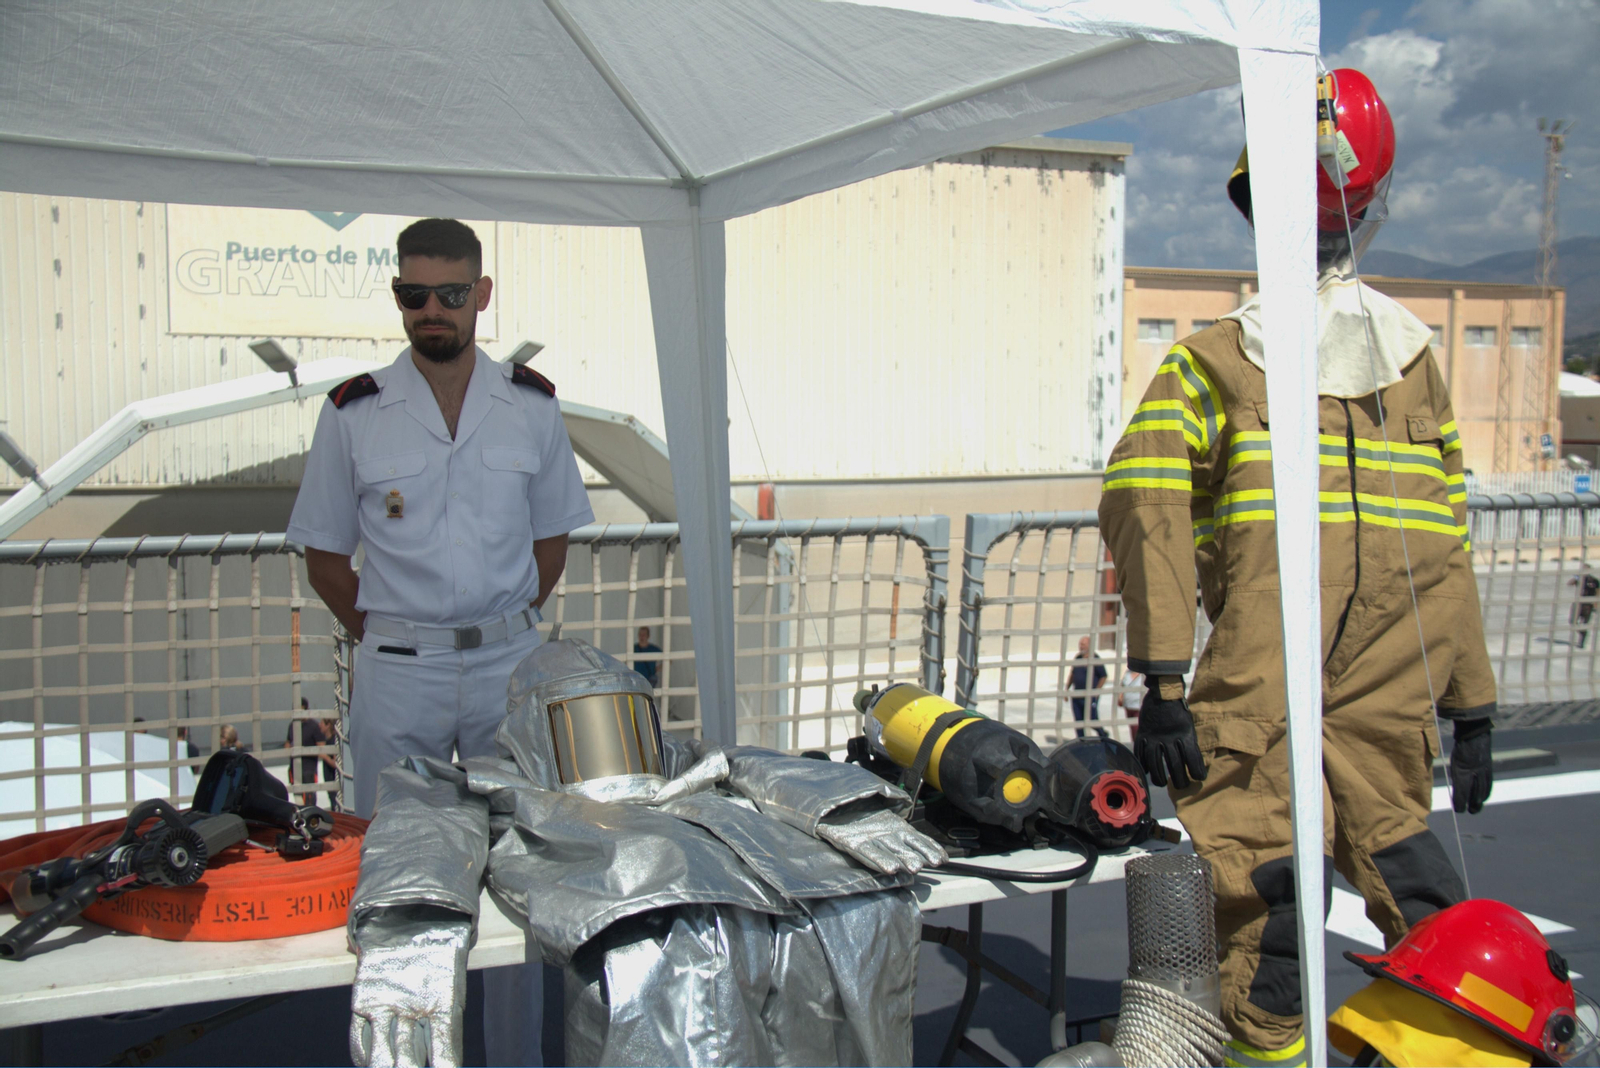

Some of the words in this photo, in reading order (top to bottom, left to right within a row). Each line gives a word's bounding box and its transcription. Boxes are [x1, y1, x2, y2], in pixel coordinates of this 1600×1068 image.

[226, 241, 317, 264] Puerto
[326, 244, 357, 265] de
[367, 247, 399, 267] Mo
[176, 248, 397, 300] GRANA
[111, 895, 200, 924] PRESSURE
[213, 901, 269, 922] TEST
[286, 885, 355, 918] RVICE
